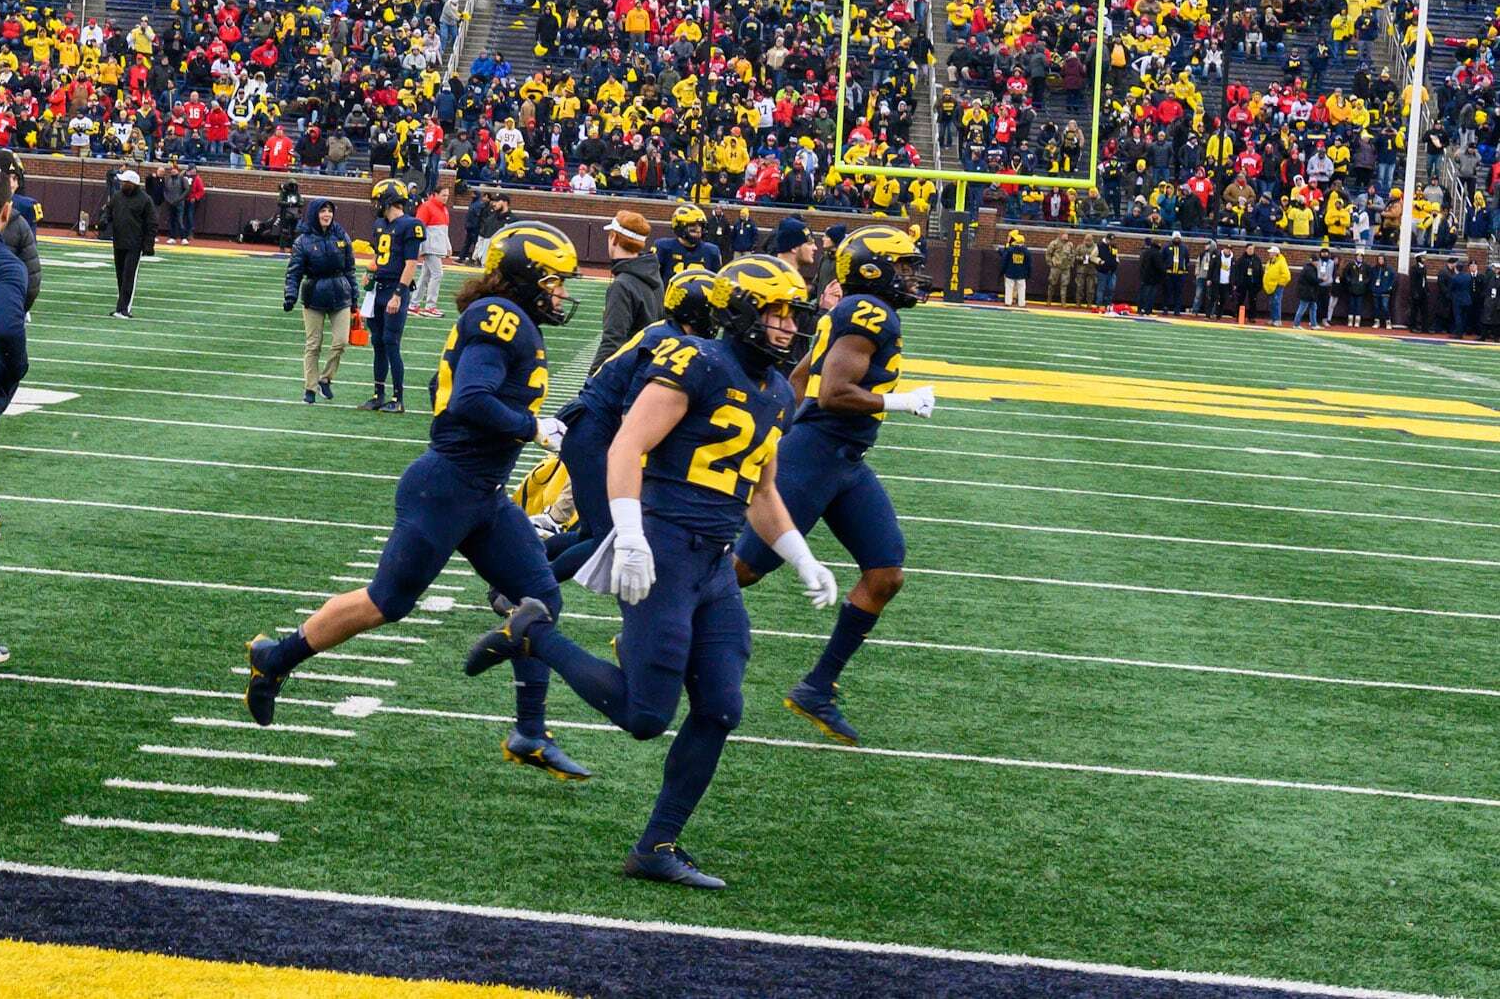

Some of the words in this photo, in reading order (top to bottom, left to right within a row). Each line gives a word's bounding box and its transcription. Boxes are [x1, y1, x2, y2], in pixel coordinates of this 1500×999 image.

[376, 233, 392, 266] 9
[414, 225, 424, 238] 9
[479, 304, 520, 342] 36
[851, 300, 888, 334] 22
[651, 338, 698, 376] 24
[686, 404, 783, 505] 24
